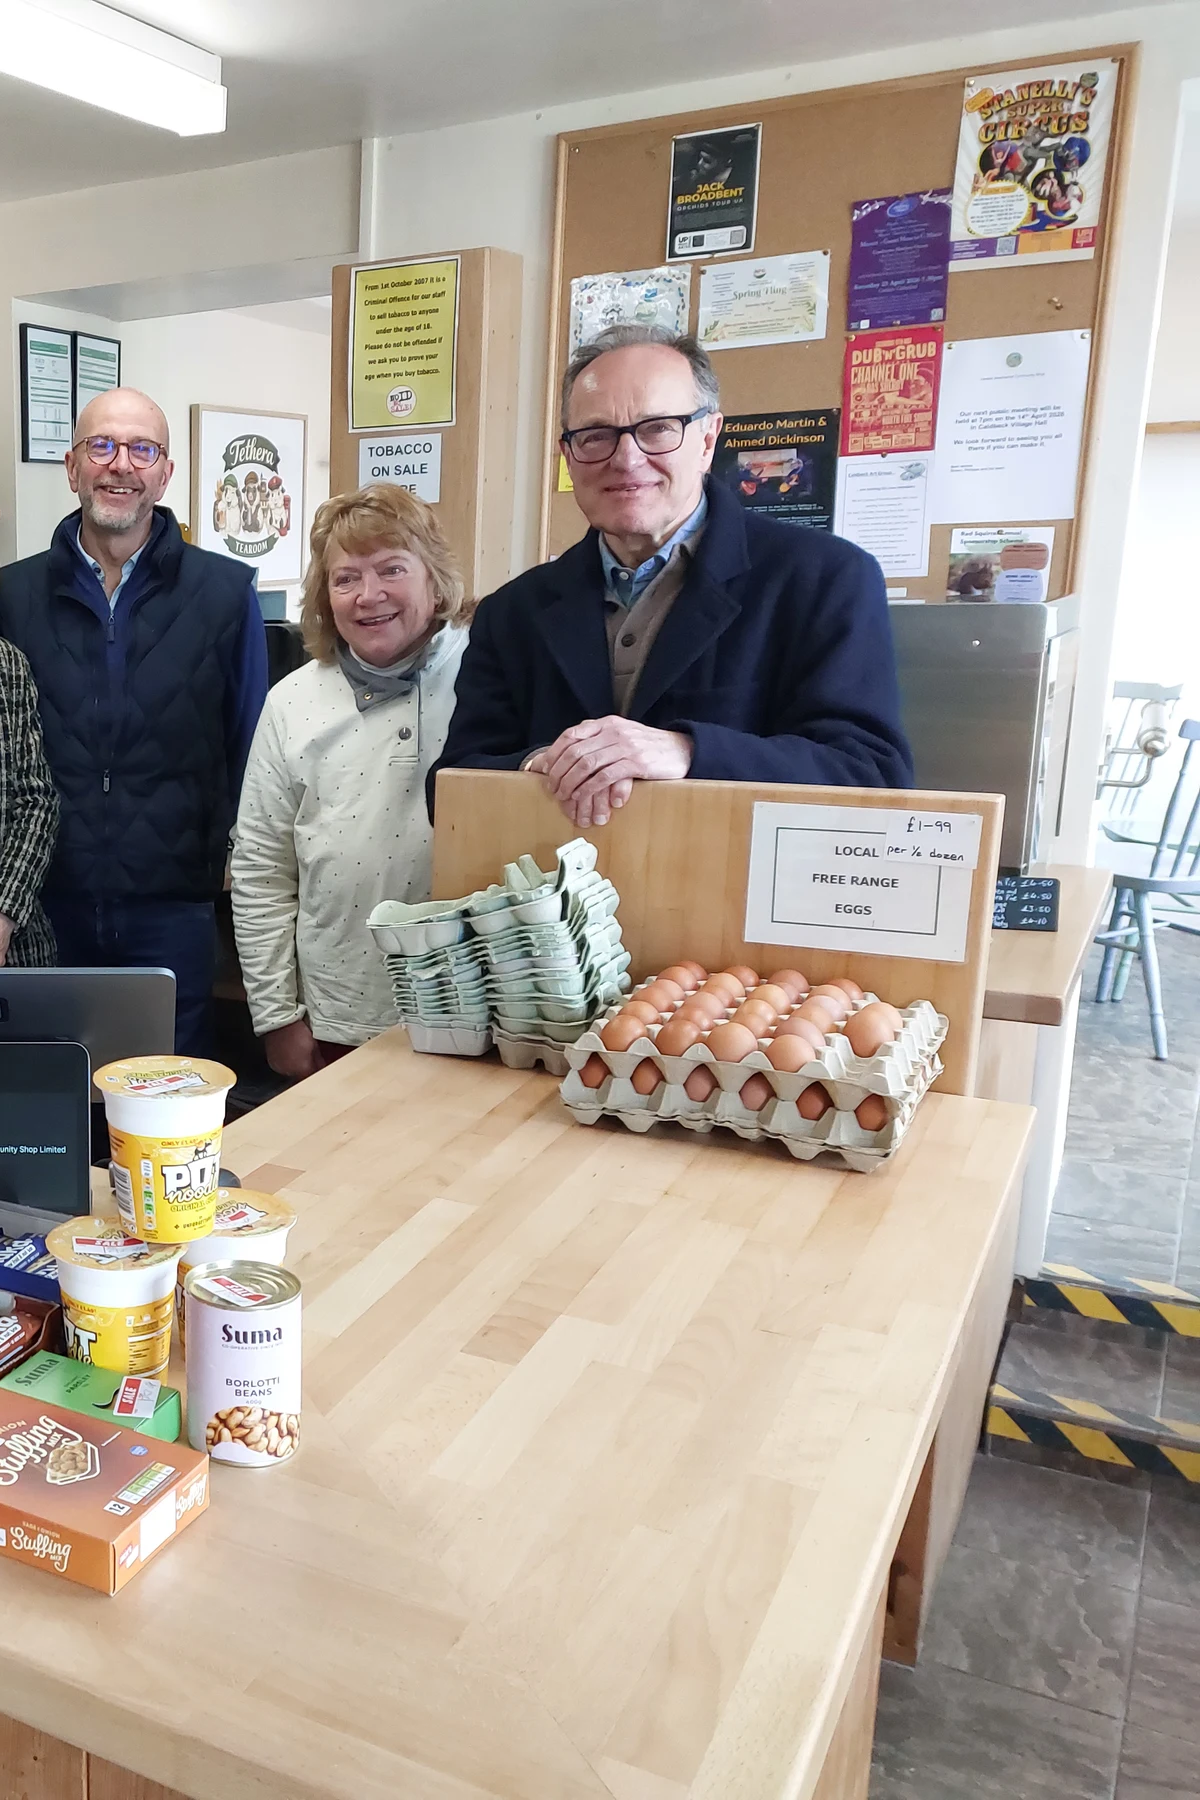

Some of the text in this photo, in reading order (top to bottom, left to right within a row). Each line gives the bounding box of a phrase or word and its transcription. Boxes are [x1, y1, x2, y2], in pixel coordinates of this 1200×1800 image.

[1007, 101, 1063, 118] SUPER
[979, 112, 1089, 143] CIRCUS
[697, 182, 726, 194] JACK
[677, 187, 745, 204] BROADBENT
[391, 280, 413, 288] October
[364, 294, 411, 306] Criminal Offence
[732, 288, 762, 300] Spring
[388, 307, 440, 319] tobacco anyone
[376, 327, 392, 335] under
[364, 337, 437, 351] Please offended
[408, 354, 425, 363] prove
[852, 342, 936, 366] DUB GRUB
[852, 362, 919, 384] CHANNEL ONE
[725, 416, 827, 433] Eduardo Martin &
[724, 434, 825, 448] Ahmed Dickinson
[230, 436, 275, 467] Tethera
[368, 442, 432, 458] TOBACCO
[371, 463, 428, 477] ON SALE
[235, 540, 268, 555] TEAROOM
[835, 845, 880, 858] LOCAL
[886, 845, 964, 862] per dozen
[812, 873, 900, 889] FREE RANGE
[834, 903, 873, 916] EGGS
[19, 1145, 38, 1154] Shop
[39, 1145, 66, 1153] Limited
[94, 1239, 125, 1247] SALE
[221, 1323, 283, 1345] Suma
[15, 1356, 60, 1387] Suma
[225, 1376, 280, 1388] BORLOTTI
[121, 1386, 137, 1405] SALE
[234, 1388, 273, 1397] BEANS
[46, 1431, 64, 1448] MIX
[108, 1503, 125, 1512] 12
[10, 1526, 72, 1572] Stuffing
